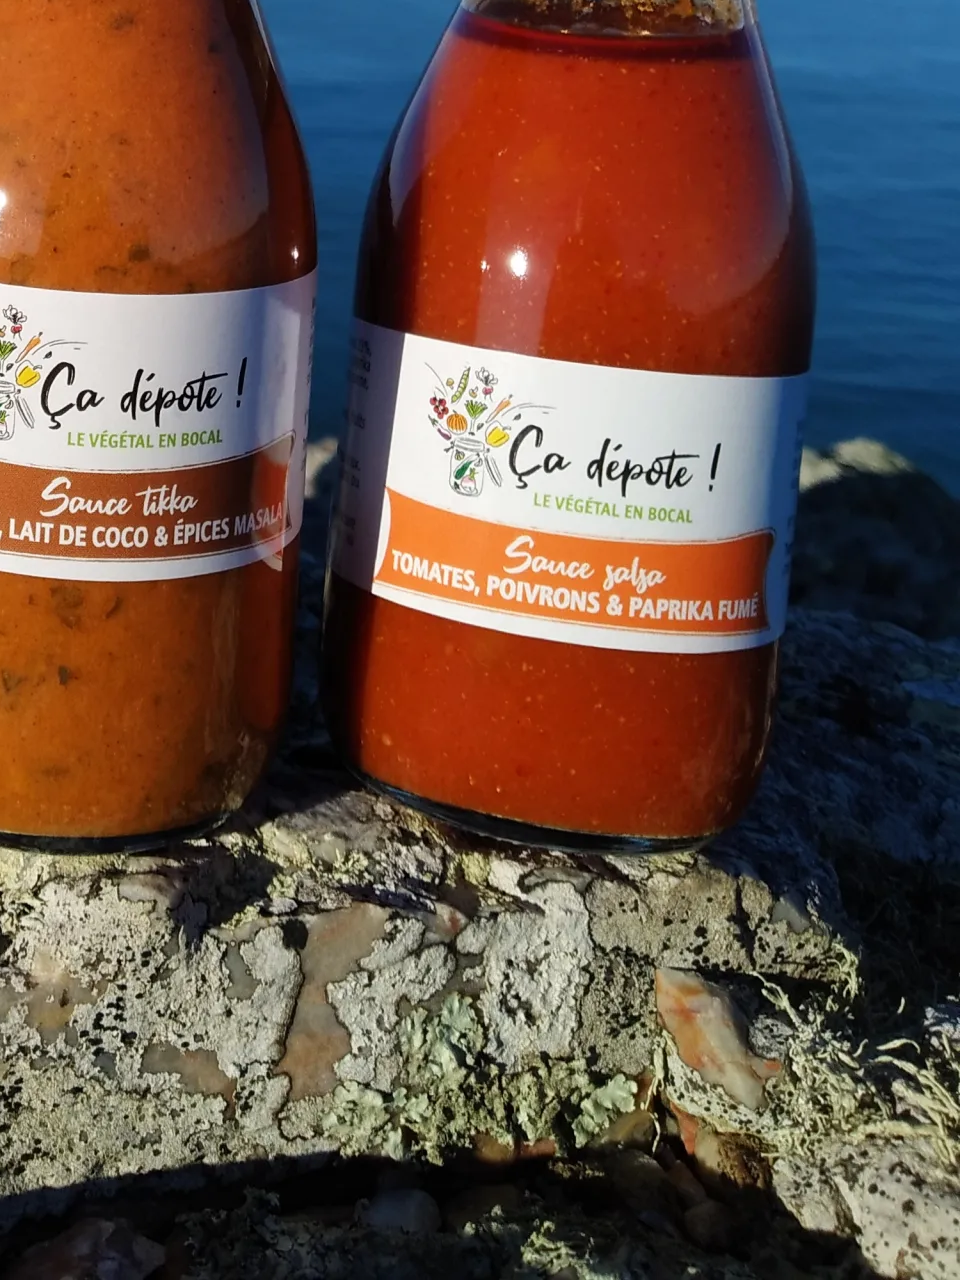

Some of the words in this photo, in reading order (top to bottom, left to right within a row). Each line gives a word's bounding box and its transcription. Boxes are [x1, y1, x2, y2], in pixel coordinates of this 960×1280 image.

[40, 361, 105, 430] Ça
[120, 368, 229, 428] dépote
[235, 356, 249, 408] !
[67, 431, 86, 449] LE
[89, 430, 155, 450] VÉGÉTAL
[159, 432, 178, 449] EN
[181, 430, 224, 448] BOCAL
[508, 424, 572, 490] Ça
[587, 438, 701, 498] dépote
[708, 443, 722, 492] !
[40, 476, 132, 518] Sauce
[136, 484, 198, 516] tikka
[533, 492, 552, 509] LE
[555, 494, 620, 518] VÉGÉTAL
[625, 503, 644, 520] EN
[647, 506, 694, 524] BOCAL
[8, 519, 54, 545] LAIT
[59, 524, 88, 547] DE
[91, 525, 150, 549] COCO
[153, 527, 170, 548] &
[173, 517, 230, 544] ÉPICES
[234, 501, 283, 536] MASALA
[391, 548, 480, 597] TOMATES,
[486, 575, 601, 614] POIVRONS
[606, 594, 623, 616] &
[628, 596, 714, 621] PAPRIKA
[717, 591, 759, 619] FUMÉ
[503, 535, 596, 579] Sauce
[603, 557, 667, 594] salsa
